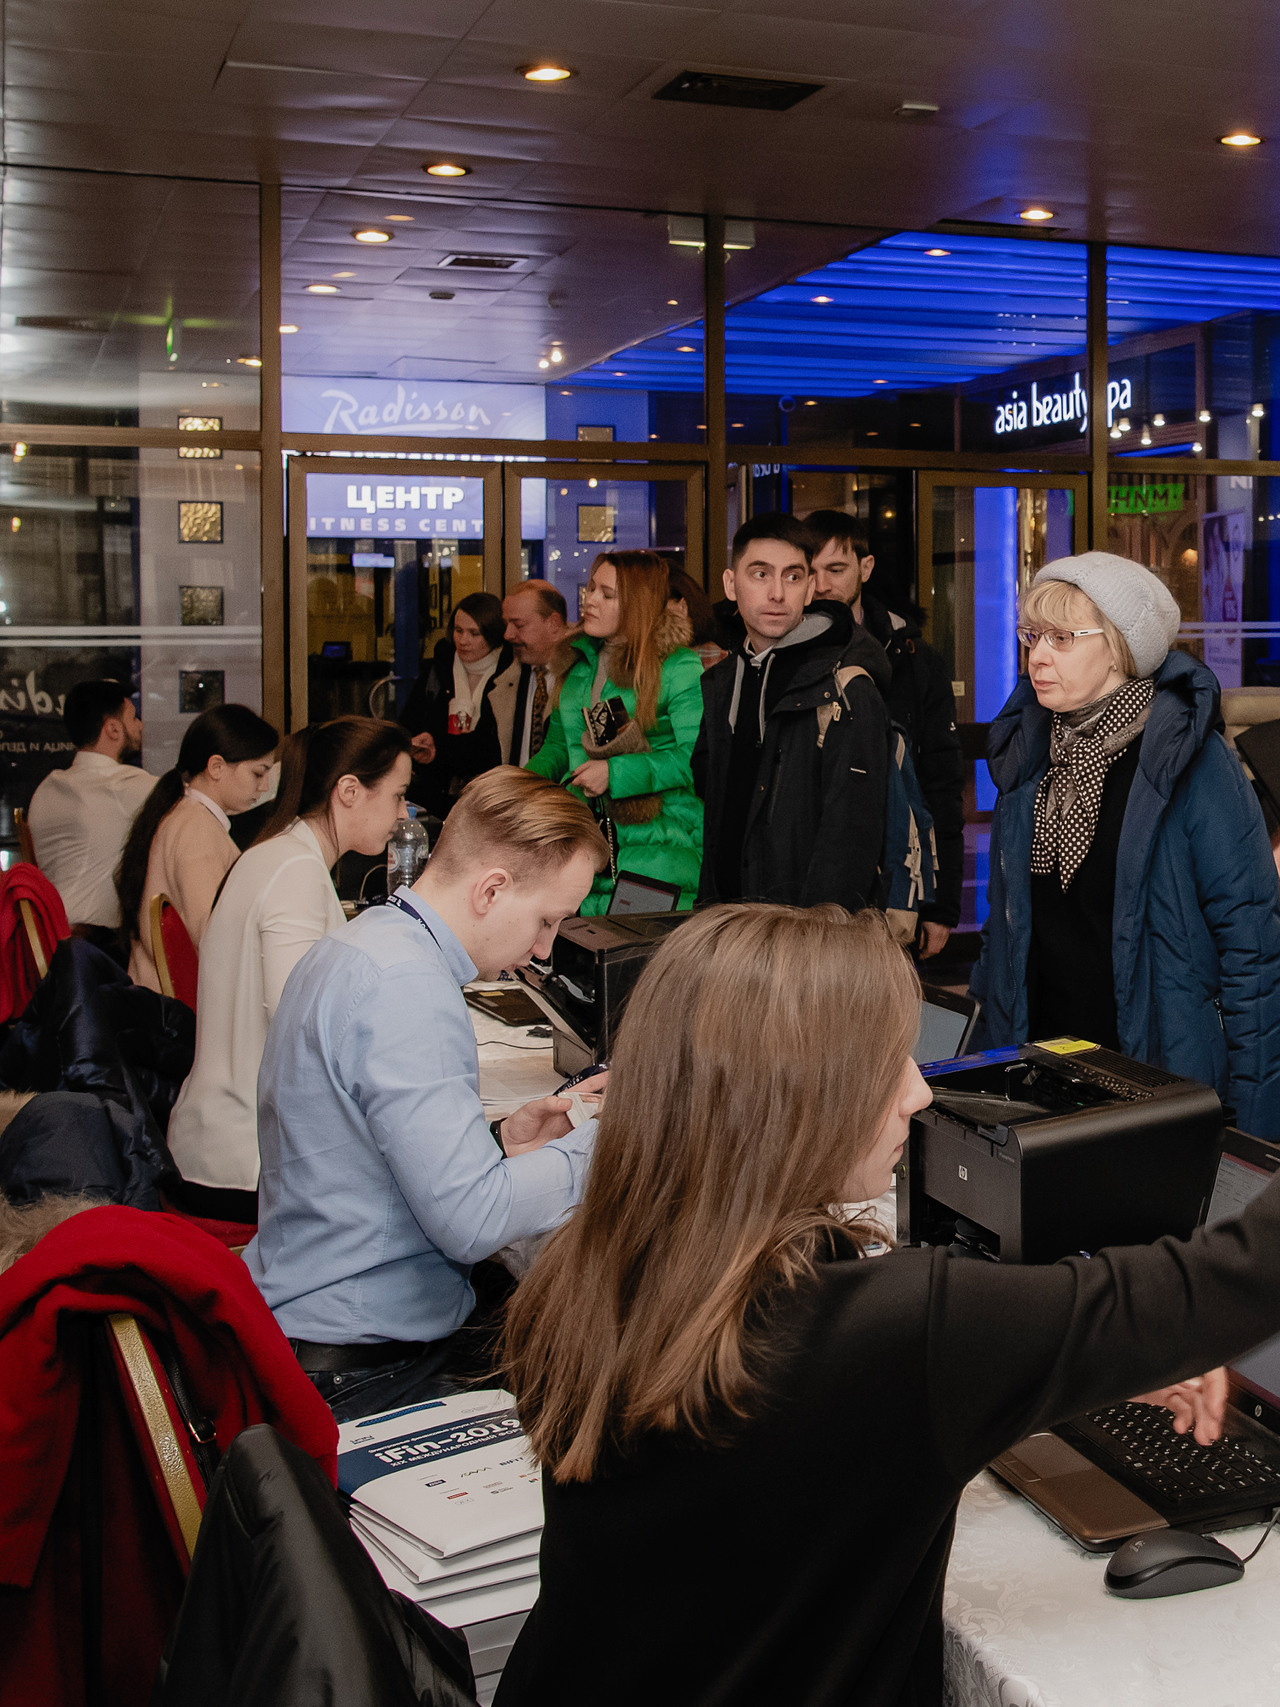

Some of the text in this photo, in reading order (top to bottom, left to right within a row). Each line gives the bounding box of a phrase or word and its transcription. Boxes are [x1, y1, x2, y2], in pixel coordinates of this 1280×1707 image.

[321, 384, 492, 433] Radisson
[994, 390, 1028, 434] asia
[1107, 378, 1132, 429] pa
[347, 485, 465, 513] ЦЕНТР
[310, 517, 484, 533] ITNESS CENT
[374, 1418, 520, 1463] iFin-2019
